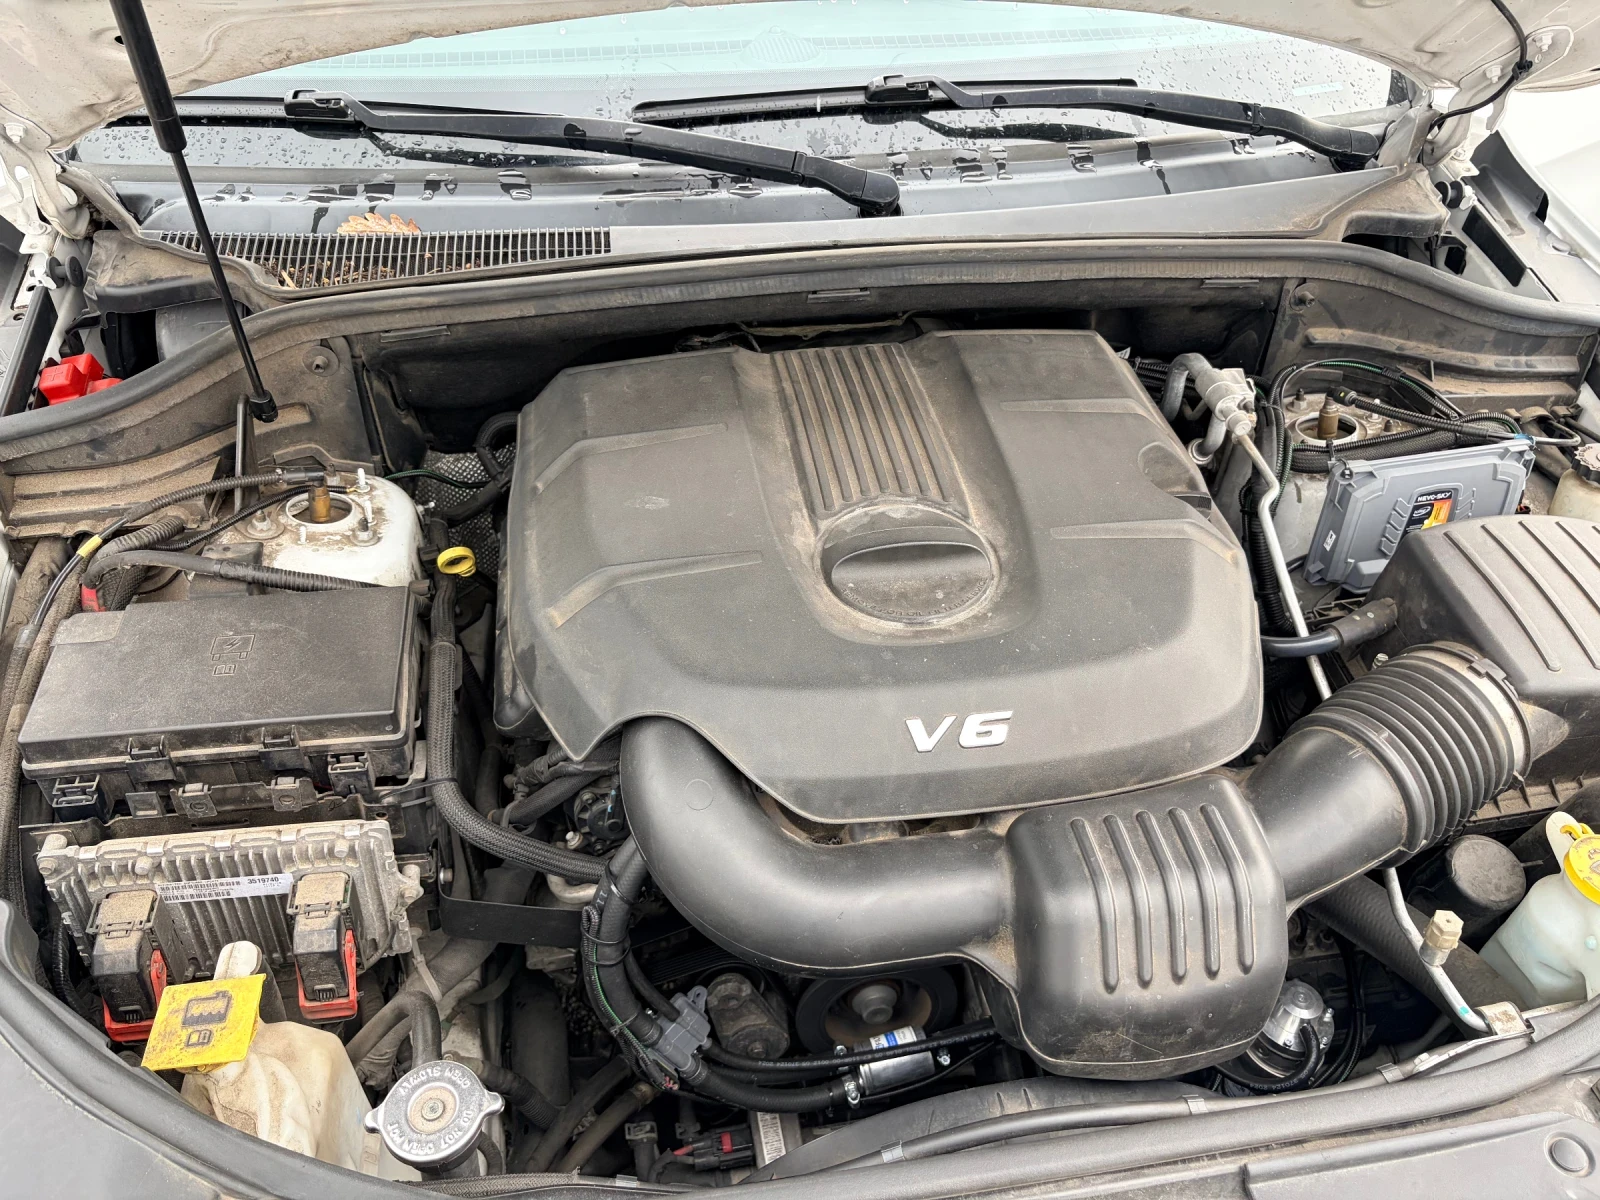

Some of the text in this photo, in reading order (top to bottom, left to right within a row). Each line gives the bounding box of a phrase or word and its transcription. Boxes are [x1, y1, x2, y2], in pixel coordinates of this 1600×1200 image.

[1417, 491, 1452, 502] NEVO-SKY
[904, 710, 1013, 753] V6
[247, 876, 280, 885] 3519740
[398, 1066, 470, 1095] OPEN SLOWLY
[460, 1110, 474, 1127] DO
[387, 1123, 405, 1142] HOT
[441, 1128, 464, 1149] NOT
